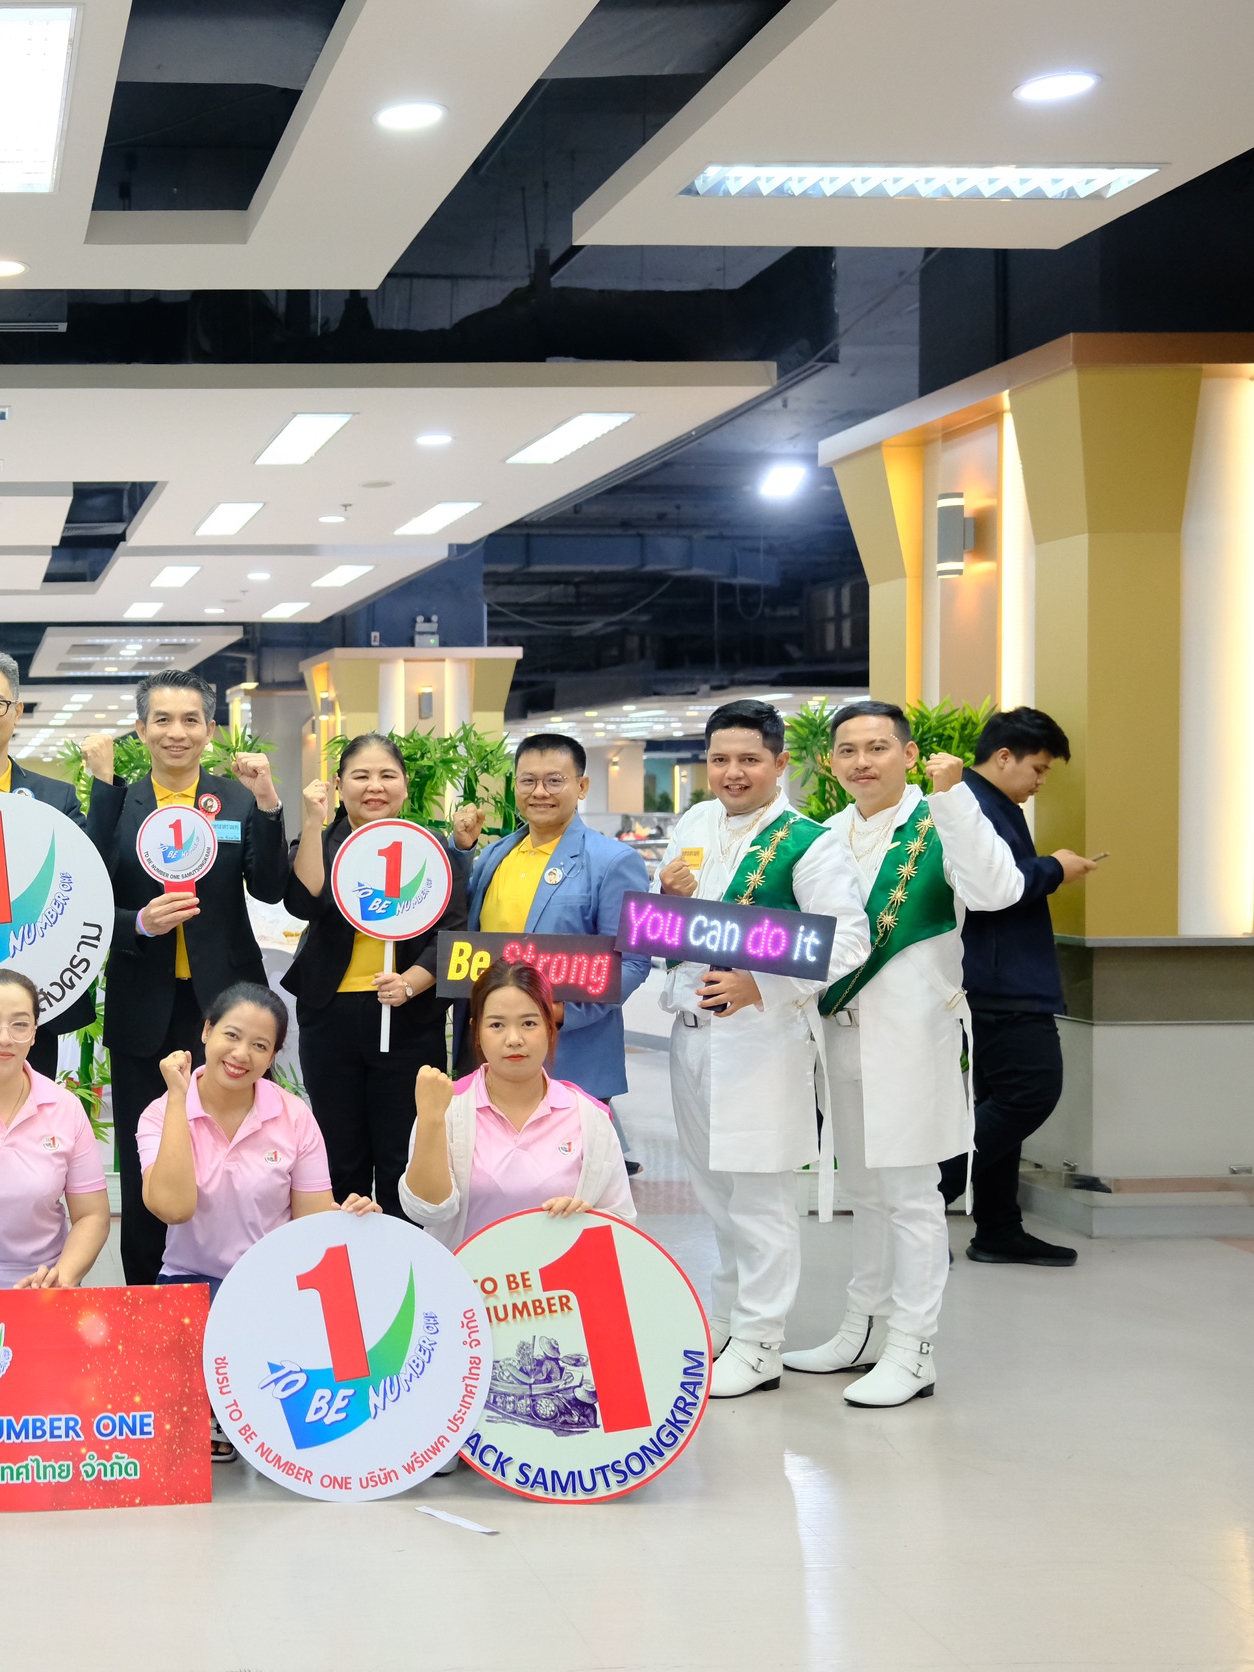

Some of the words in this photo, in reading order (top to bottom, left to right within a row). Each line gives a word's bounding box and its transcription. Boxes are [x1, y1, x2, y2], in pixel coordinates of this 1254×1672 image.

[143, 850, 150, 858] TO
[169, 819, 183, 850] 1
[146, 858, 154, 866] BE
[150, 863, 170, 879] NUMBER
[378, 841, 402, 898] 1
[352, 881, 374, 899] TO
[367, 898, 392, 914] BE
[8, 891, 70, 959] NUMBER
[628, 901, 683, 947] You
[689, 913, 741, 952] can
[747, 918, 788, 958] do
[793, 925, 822, 962] it
[447, 941, 491, 982] Be
[502, 941, 612, 995] Strong
[506, 1271, 533, 1292] BE
[295, 1243, 371, 1383] 1
[460, 1308, 482, 1349] จำกัด
[538, 1225, 652, 1434] 1
[214, 1355, 232, 1396] ชมรม
[258, 1360, 309, 1401] TO
[305, 1388, 356, 1425] BE
[368, 1336, 437, 1420] NUMBER
[446, 1356, 482, 1433] ประเทศไทย
[94, 1411, 155, 1440] ONE
[224, 1399, 243, 1423] TO
[514, 1349, 705, 1494] SAMUTSONGKRAM
[237, 1423, 258, 1445] BE
[401, 1434, 451, 1475] พรีแพค
[81, 1452, 139, 1481] จำกัด
[255, 1441, 314, 1485] NUMBER
[319, 1475, 352, 1490] ONE
[359, 1467, 399, 1490] บริษัท
